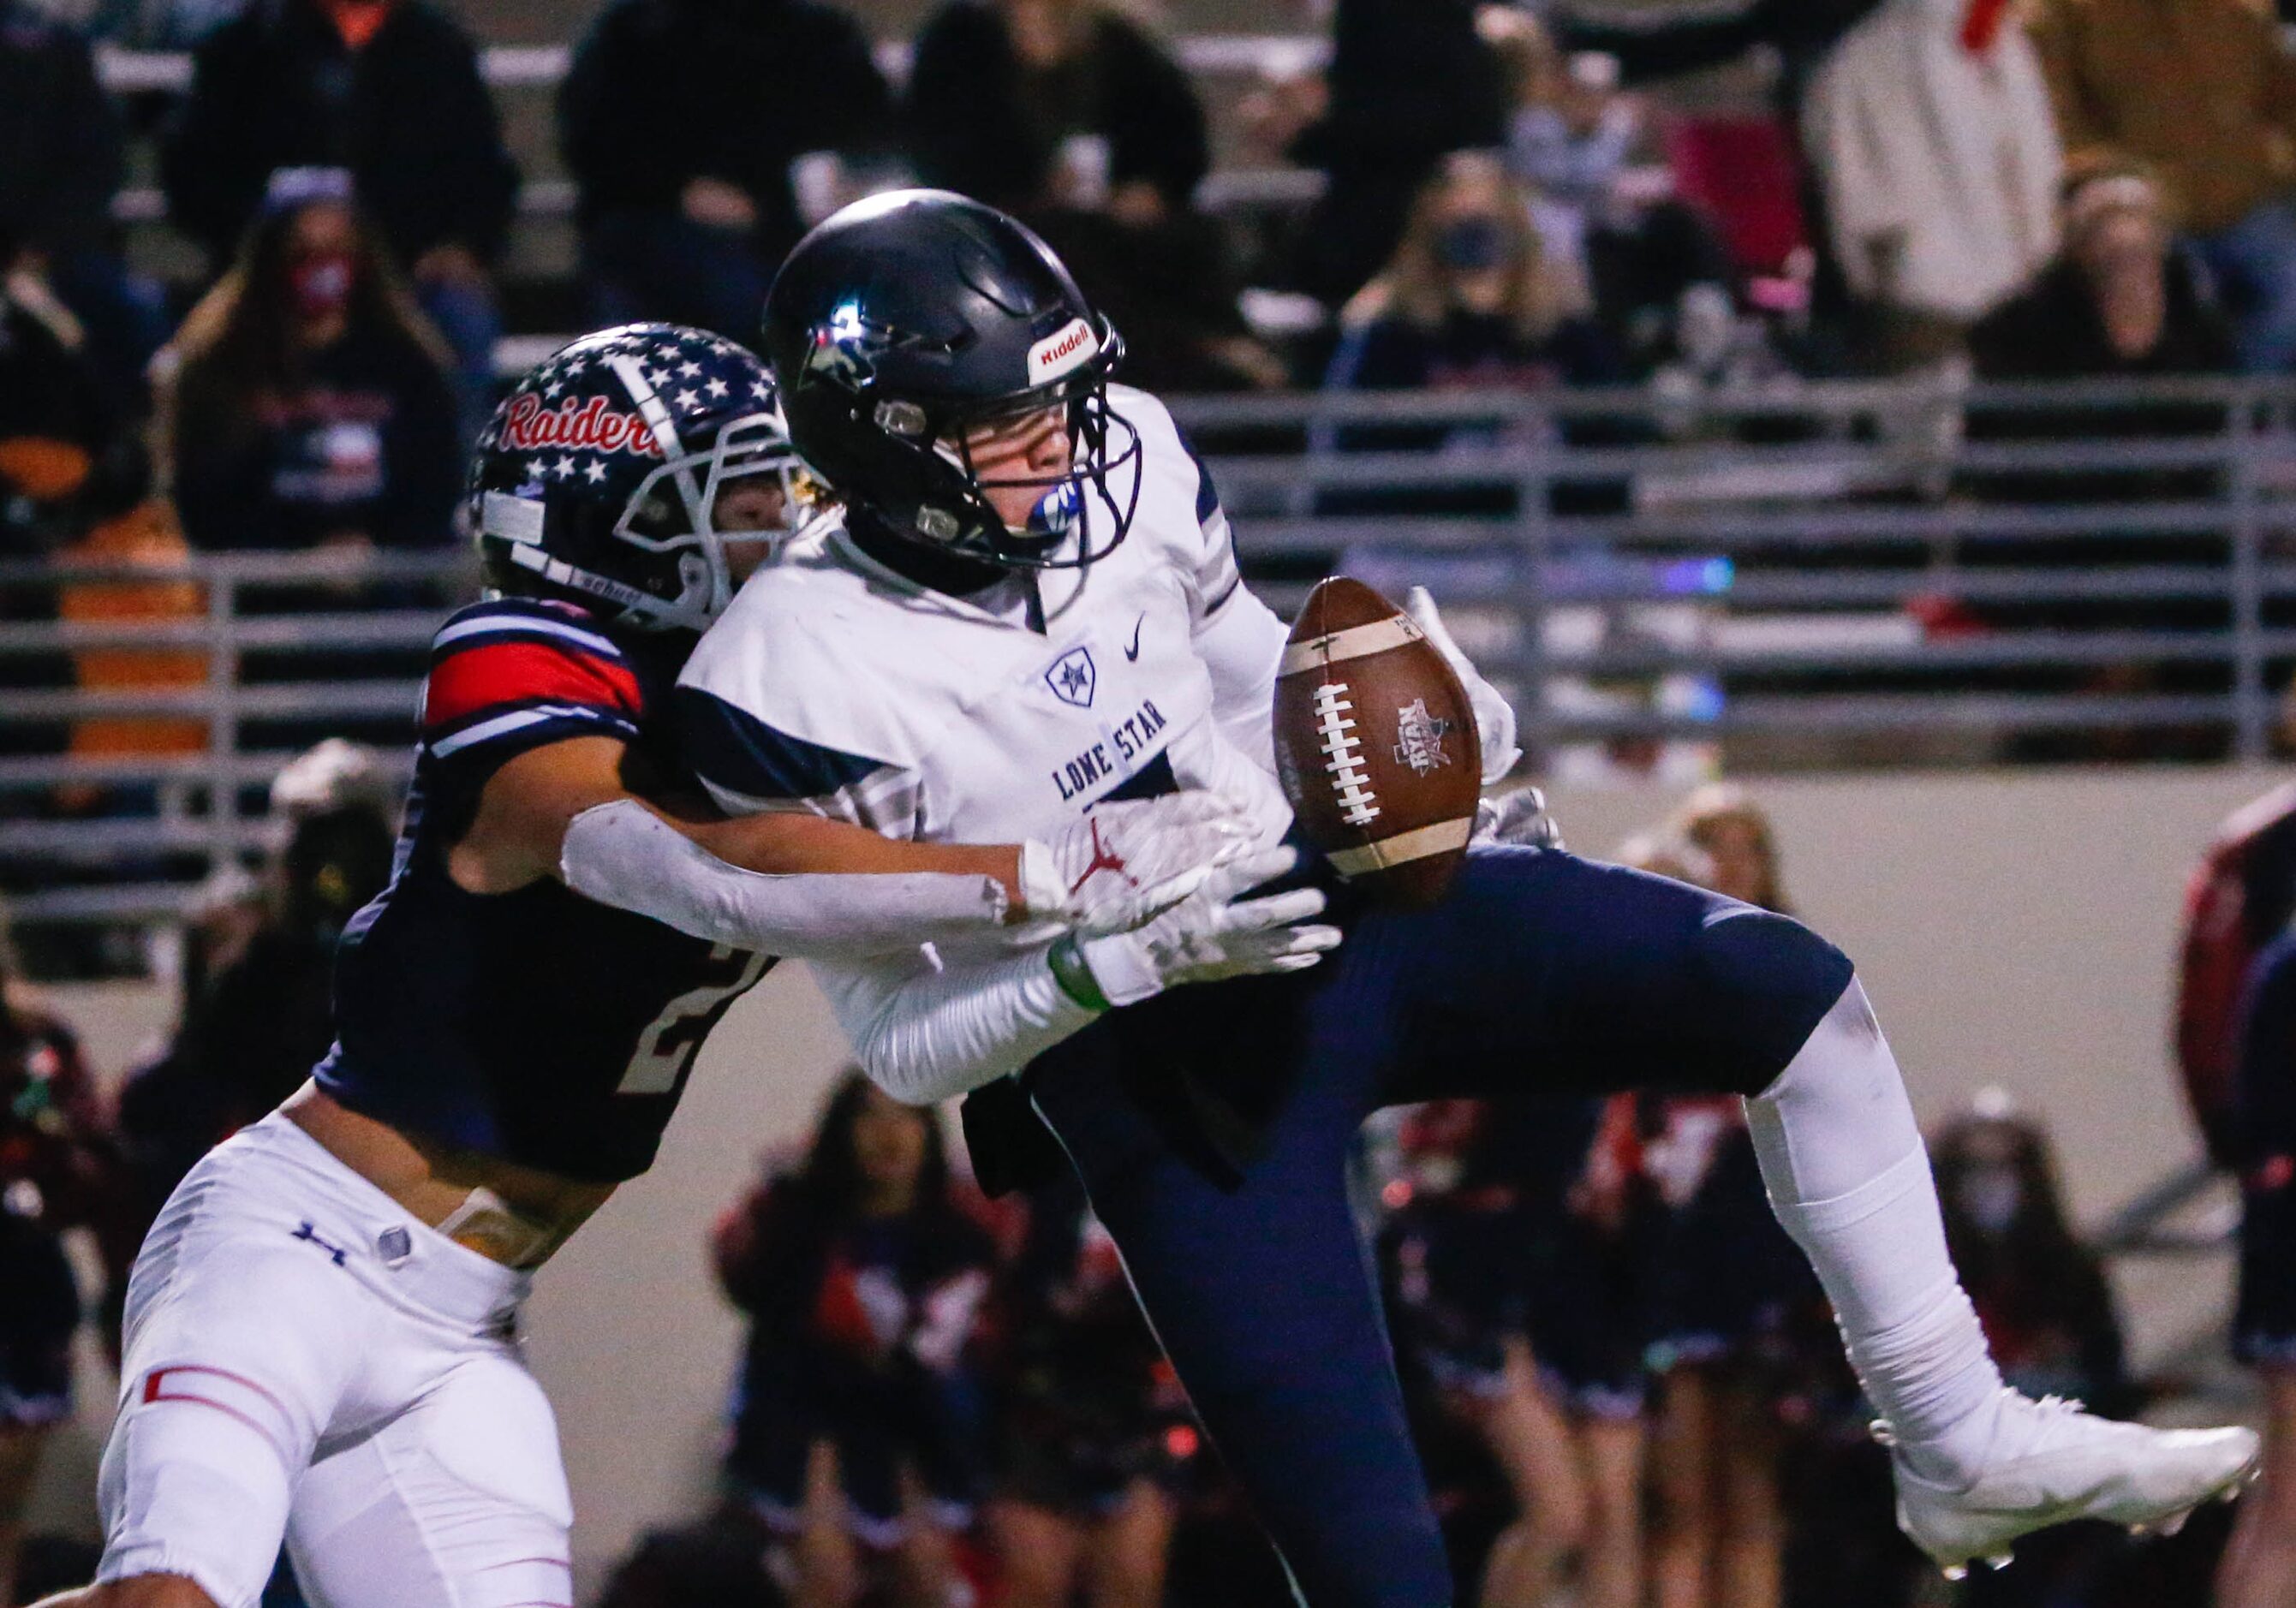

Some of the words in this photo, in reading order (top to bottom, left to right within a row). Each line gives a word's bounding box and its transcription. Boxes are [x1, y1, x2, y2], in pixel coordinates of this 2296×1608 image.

[1041, 324, 1088, 366] Riddell
[1053, 742, 1112, 801] LONE
[1113, 699, 1166, 761] STAR
[1398, 707, 1430, 770] RYAN
